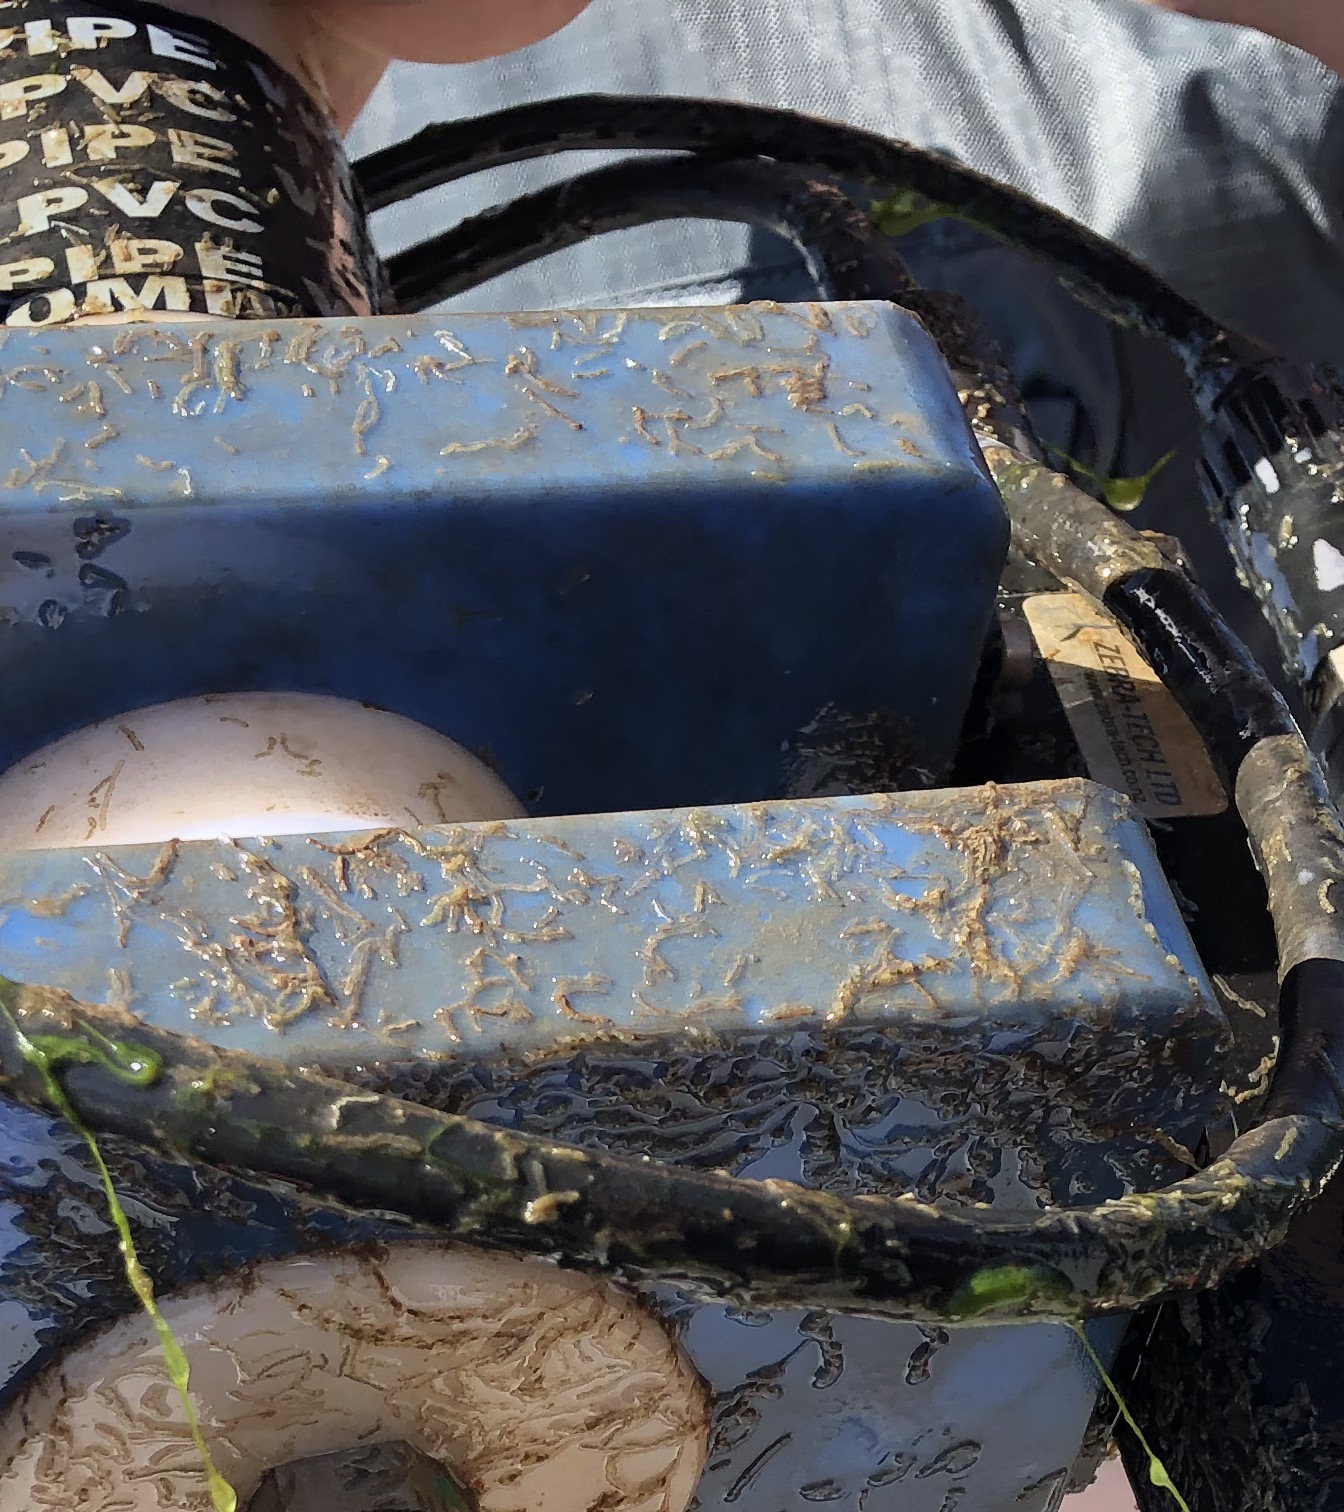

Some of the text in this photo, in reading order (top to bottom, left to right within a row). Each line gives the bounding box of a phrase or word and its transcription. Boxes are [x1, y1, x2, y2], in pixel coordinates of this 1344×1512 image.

[17, 178, 265, 237] PVC
[1093, 641, 1182, 806] ZEBRA-TECH LTD
